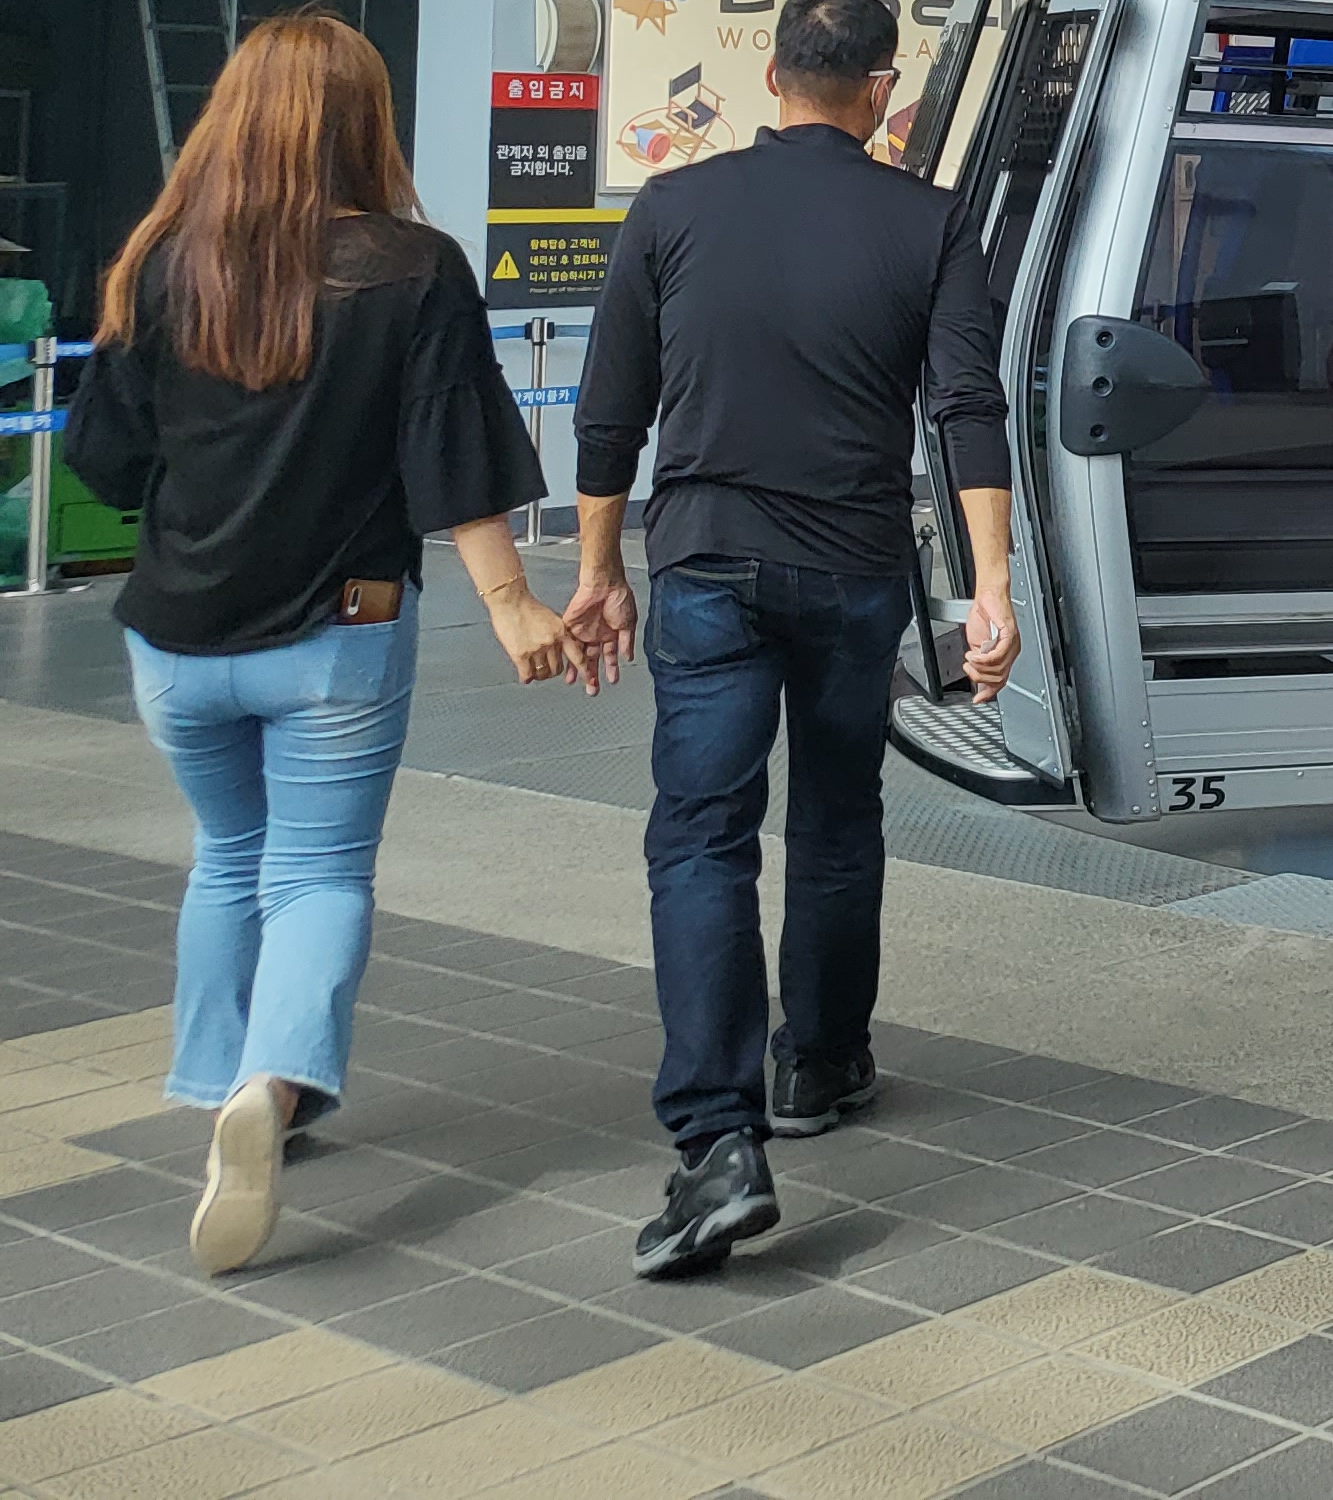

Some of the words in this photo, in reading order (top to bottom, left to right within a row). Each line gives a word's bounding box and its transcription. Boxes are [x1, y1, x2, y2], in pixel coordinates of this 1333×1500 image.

[507, 78, 585, 100] 출입금지
[496, 144, 533, 160] 관계자
[536, 145, 549, 160] 외
[552, 144, 588, 160] 출입을
[509, 161, 574, 176] 금지합니다.
[1168, 775, 1226, 812] 35
